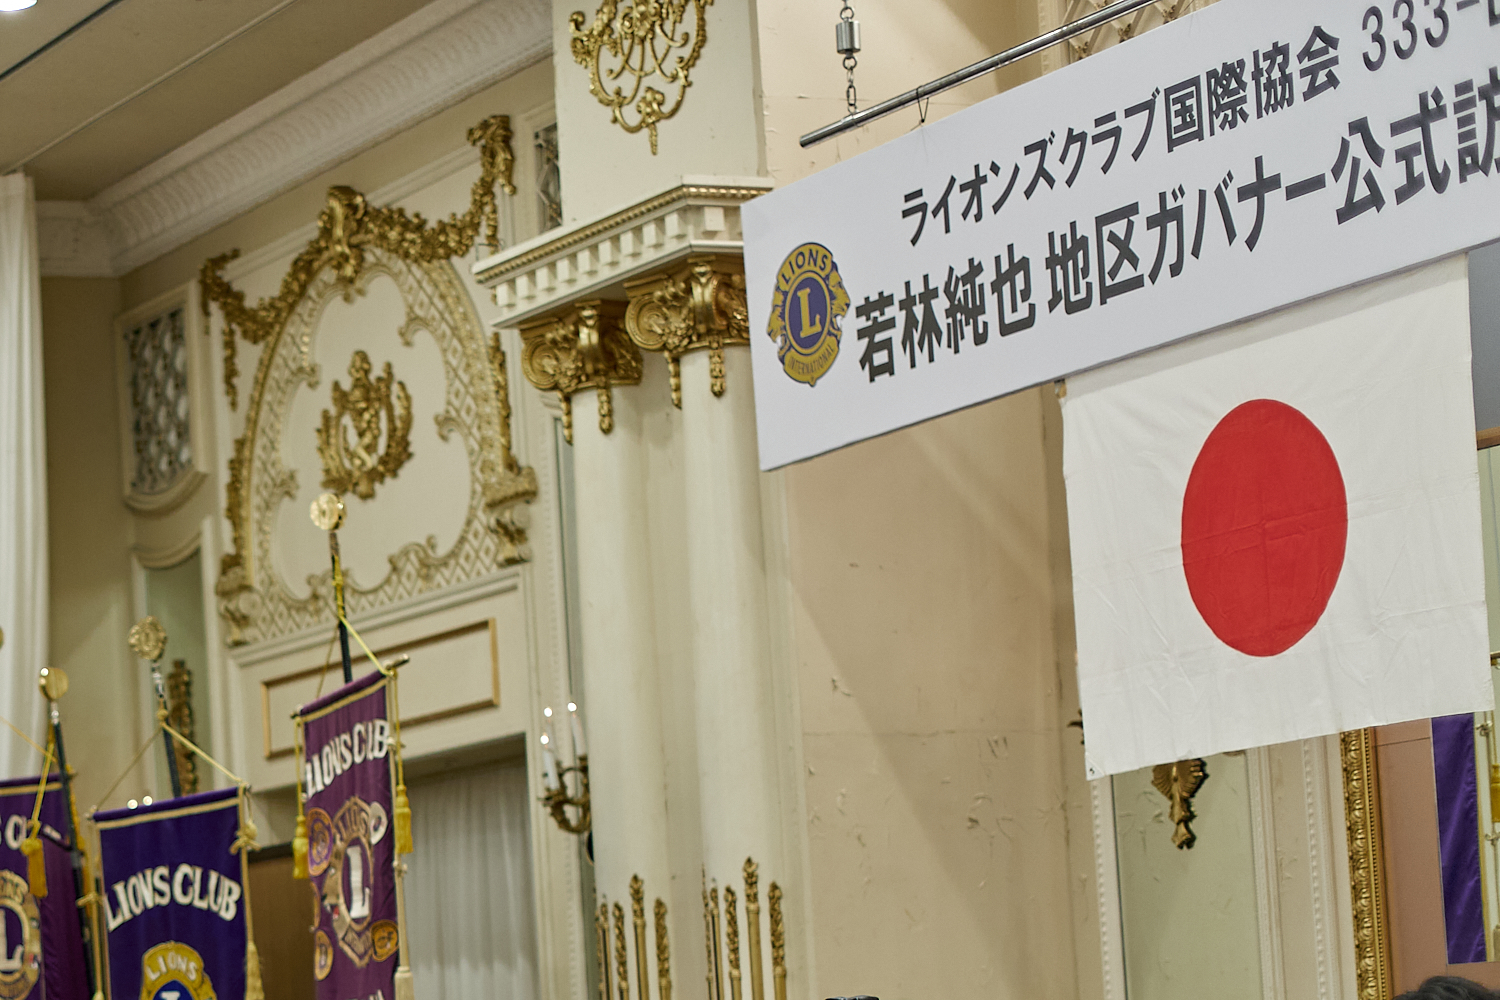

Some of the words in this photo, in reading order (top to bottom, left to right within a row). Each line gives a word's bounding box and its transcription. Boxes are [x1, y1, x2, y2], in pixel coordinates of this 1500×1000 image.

[901, 26, 1341, 246] ライオンズクラブ国際協会
[1362, 0, 1500, 72] 333-
[781, 248, 828, 285] LIONS
[797, 287, 822, 338] L
[787, 343, 835, 377] INTERNATIONAL
[305, 732, 352, 799] LIONS
[352, 719, 389, 764] CLB
[5, 814, 62, 851] CL
[103, 865, 171, 933] LIONS
[172, 863, 241, 921] CLUB
[347, 846, 370, 919] L
[146, 951, 199, 981] LIONS
